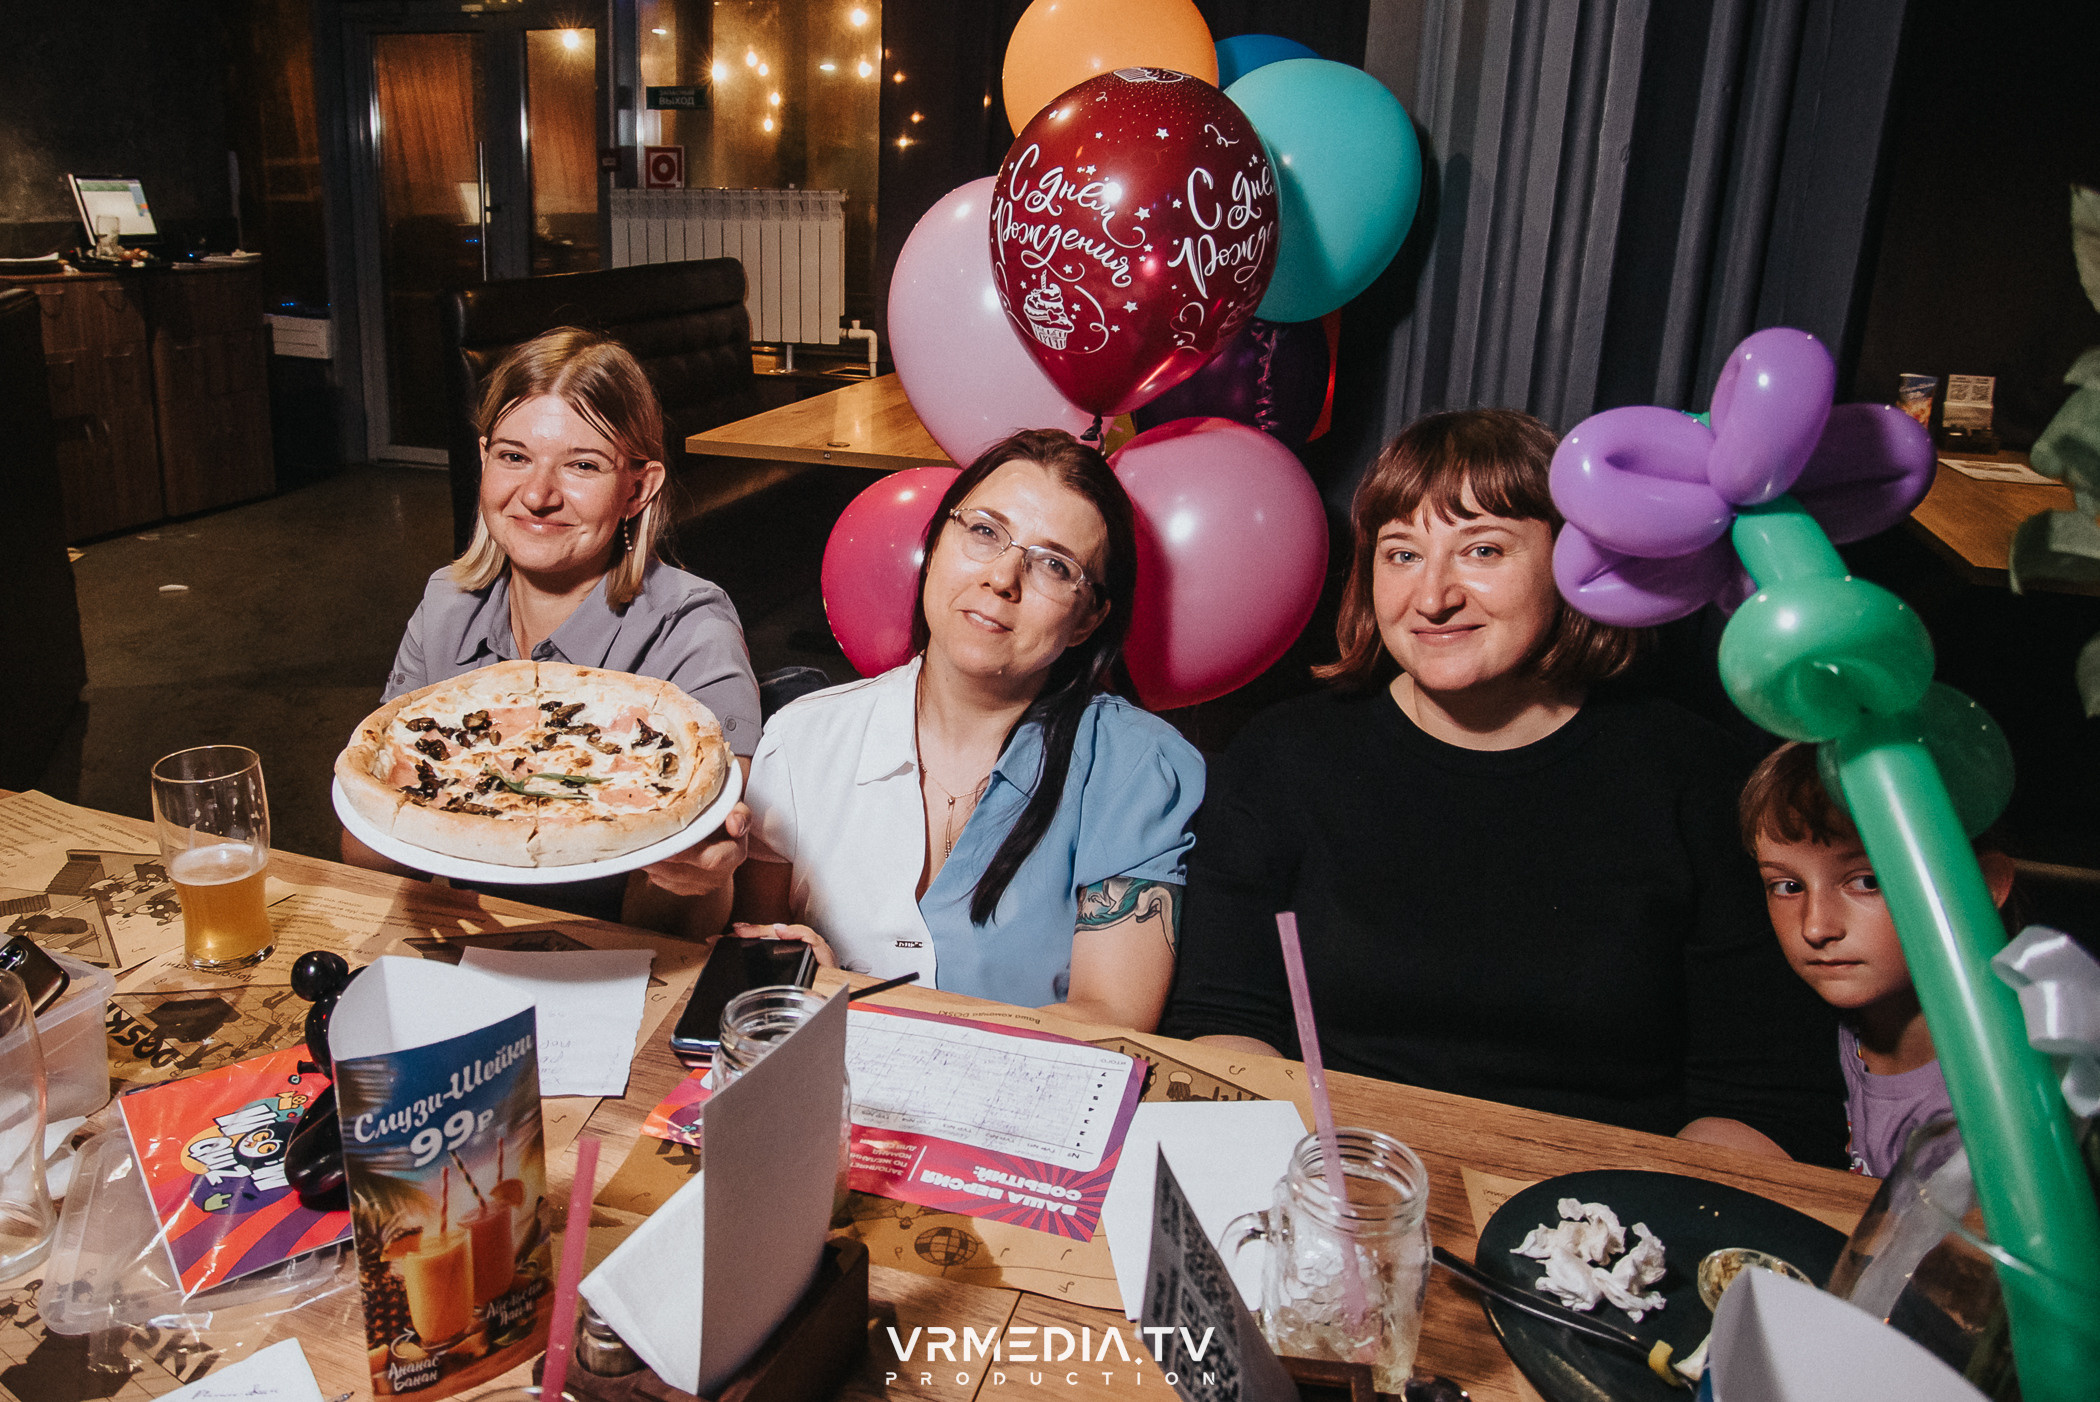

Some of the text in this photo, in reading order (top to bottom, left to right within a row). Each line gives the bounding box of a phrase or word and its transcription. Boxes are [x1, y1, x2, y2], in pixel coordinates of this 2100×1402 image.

[659, 96, 695, 106] ВЫХОД
[1015, 1014, 1041, 1024] Ваша
[188, 1137, 252, 1186] QUIZ
[849, 1152, 908, 1168] ПО ЖЕЛАНИ
[872, 1148, 912, 1159] КОМАНД
[919, 1169, 1078, 1216] ВАША ВЕРСИЯ
[972, 1165, 1082, 1201] СОБЫТИЙ:
[388, 1356, 440, 1379] Ананас
[393, 1369, 438, 1391] Банан
